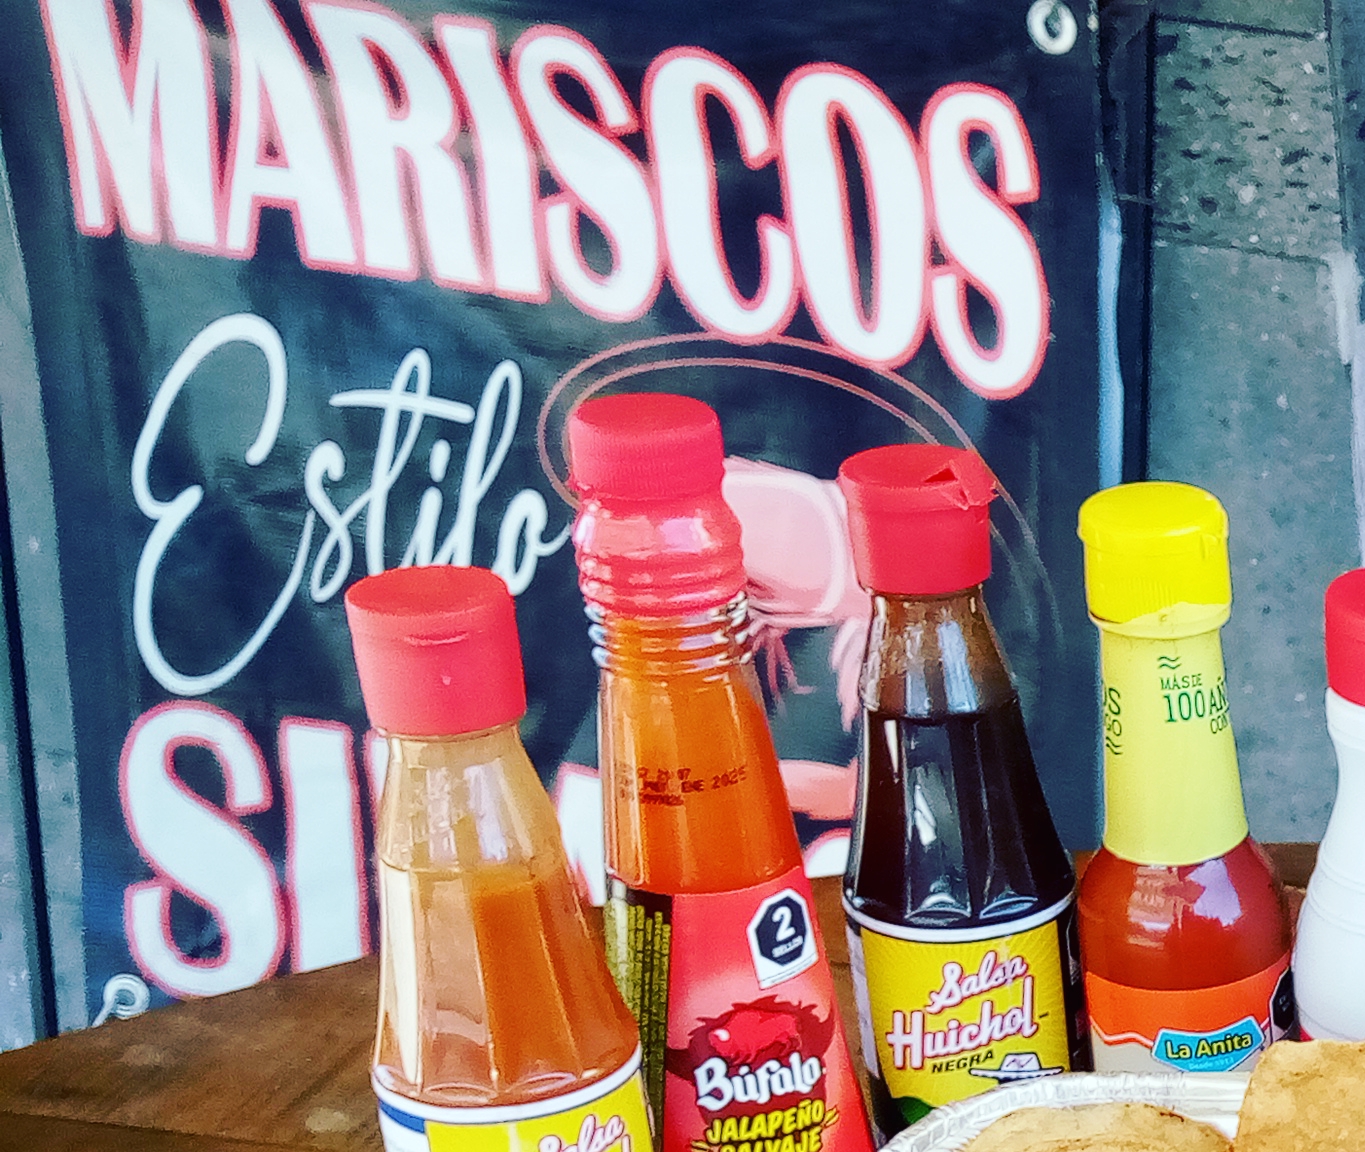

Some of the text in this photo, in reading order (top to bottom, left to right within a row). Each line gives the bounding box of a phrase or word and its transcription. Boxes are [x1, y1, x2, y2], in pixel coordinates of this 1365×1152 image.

[40, 0, 1050, 398] MARISCOS
[131, 312, 573, 696] Estilo
[1160, 673, 1202, 690] MÁS DE
[1163, 690, 1206, 723] 100
[1208, 676, 1228, 716] AÑ
[772, 906, 796, 942] 2
[925, 950, 1028, 1014] Salsa
[886, 975, 1038, 1070] Huichol
[932, 1050, 994, 1074] NEGRA
[1166, 1034, 1252, 1059] La Anita
[694, 1052, 822, 1111] Búfalo
[706, 1099, 825, 1144] JALAPEÑO
